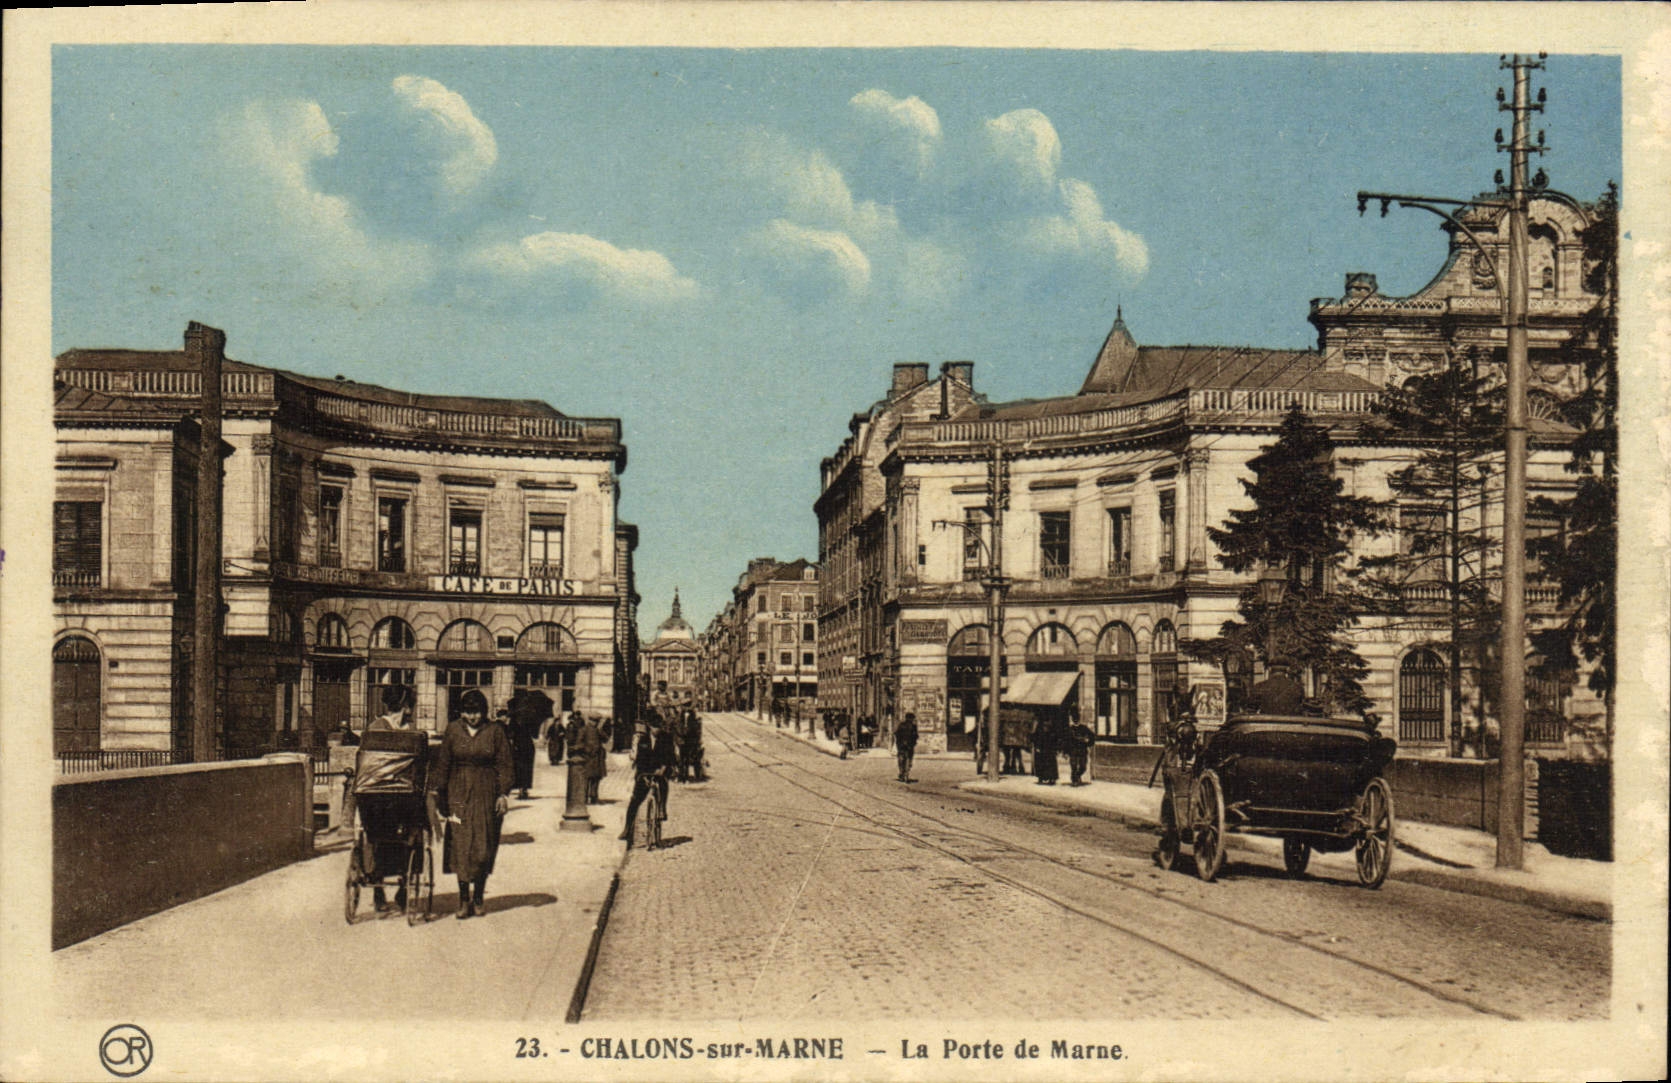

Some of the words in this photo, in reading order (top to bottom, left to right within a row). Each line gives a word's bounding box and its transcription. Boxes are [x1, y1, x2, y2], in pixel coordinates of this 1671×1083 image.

[442, 575, 494, 594] CAFE
[499, 580, 513, 591] DE
[517, 577, 575, 596] PARIS
